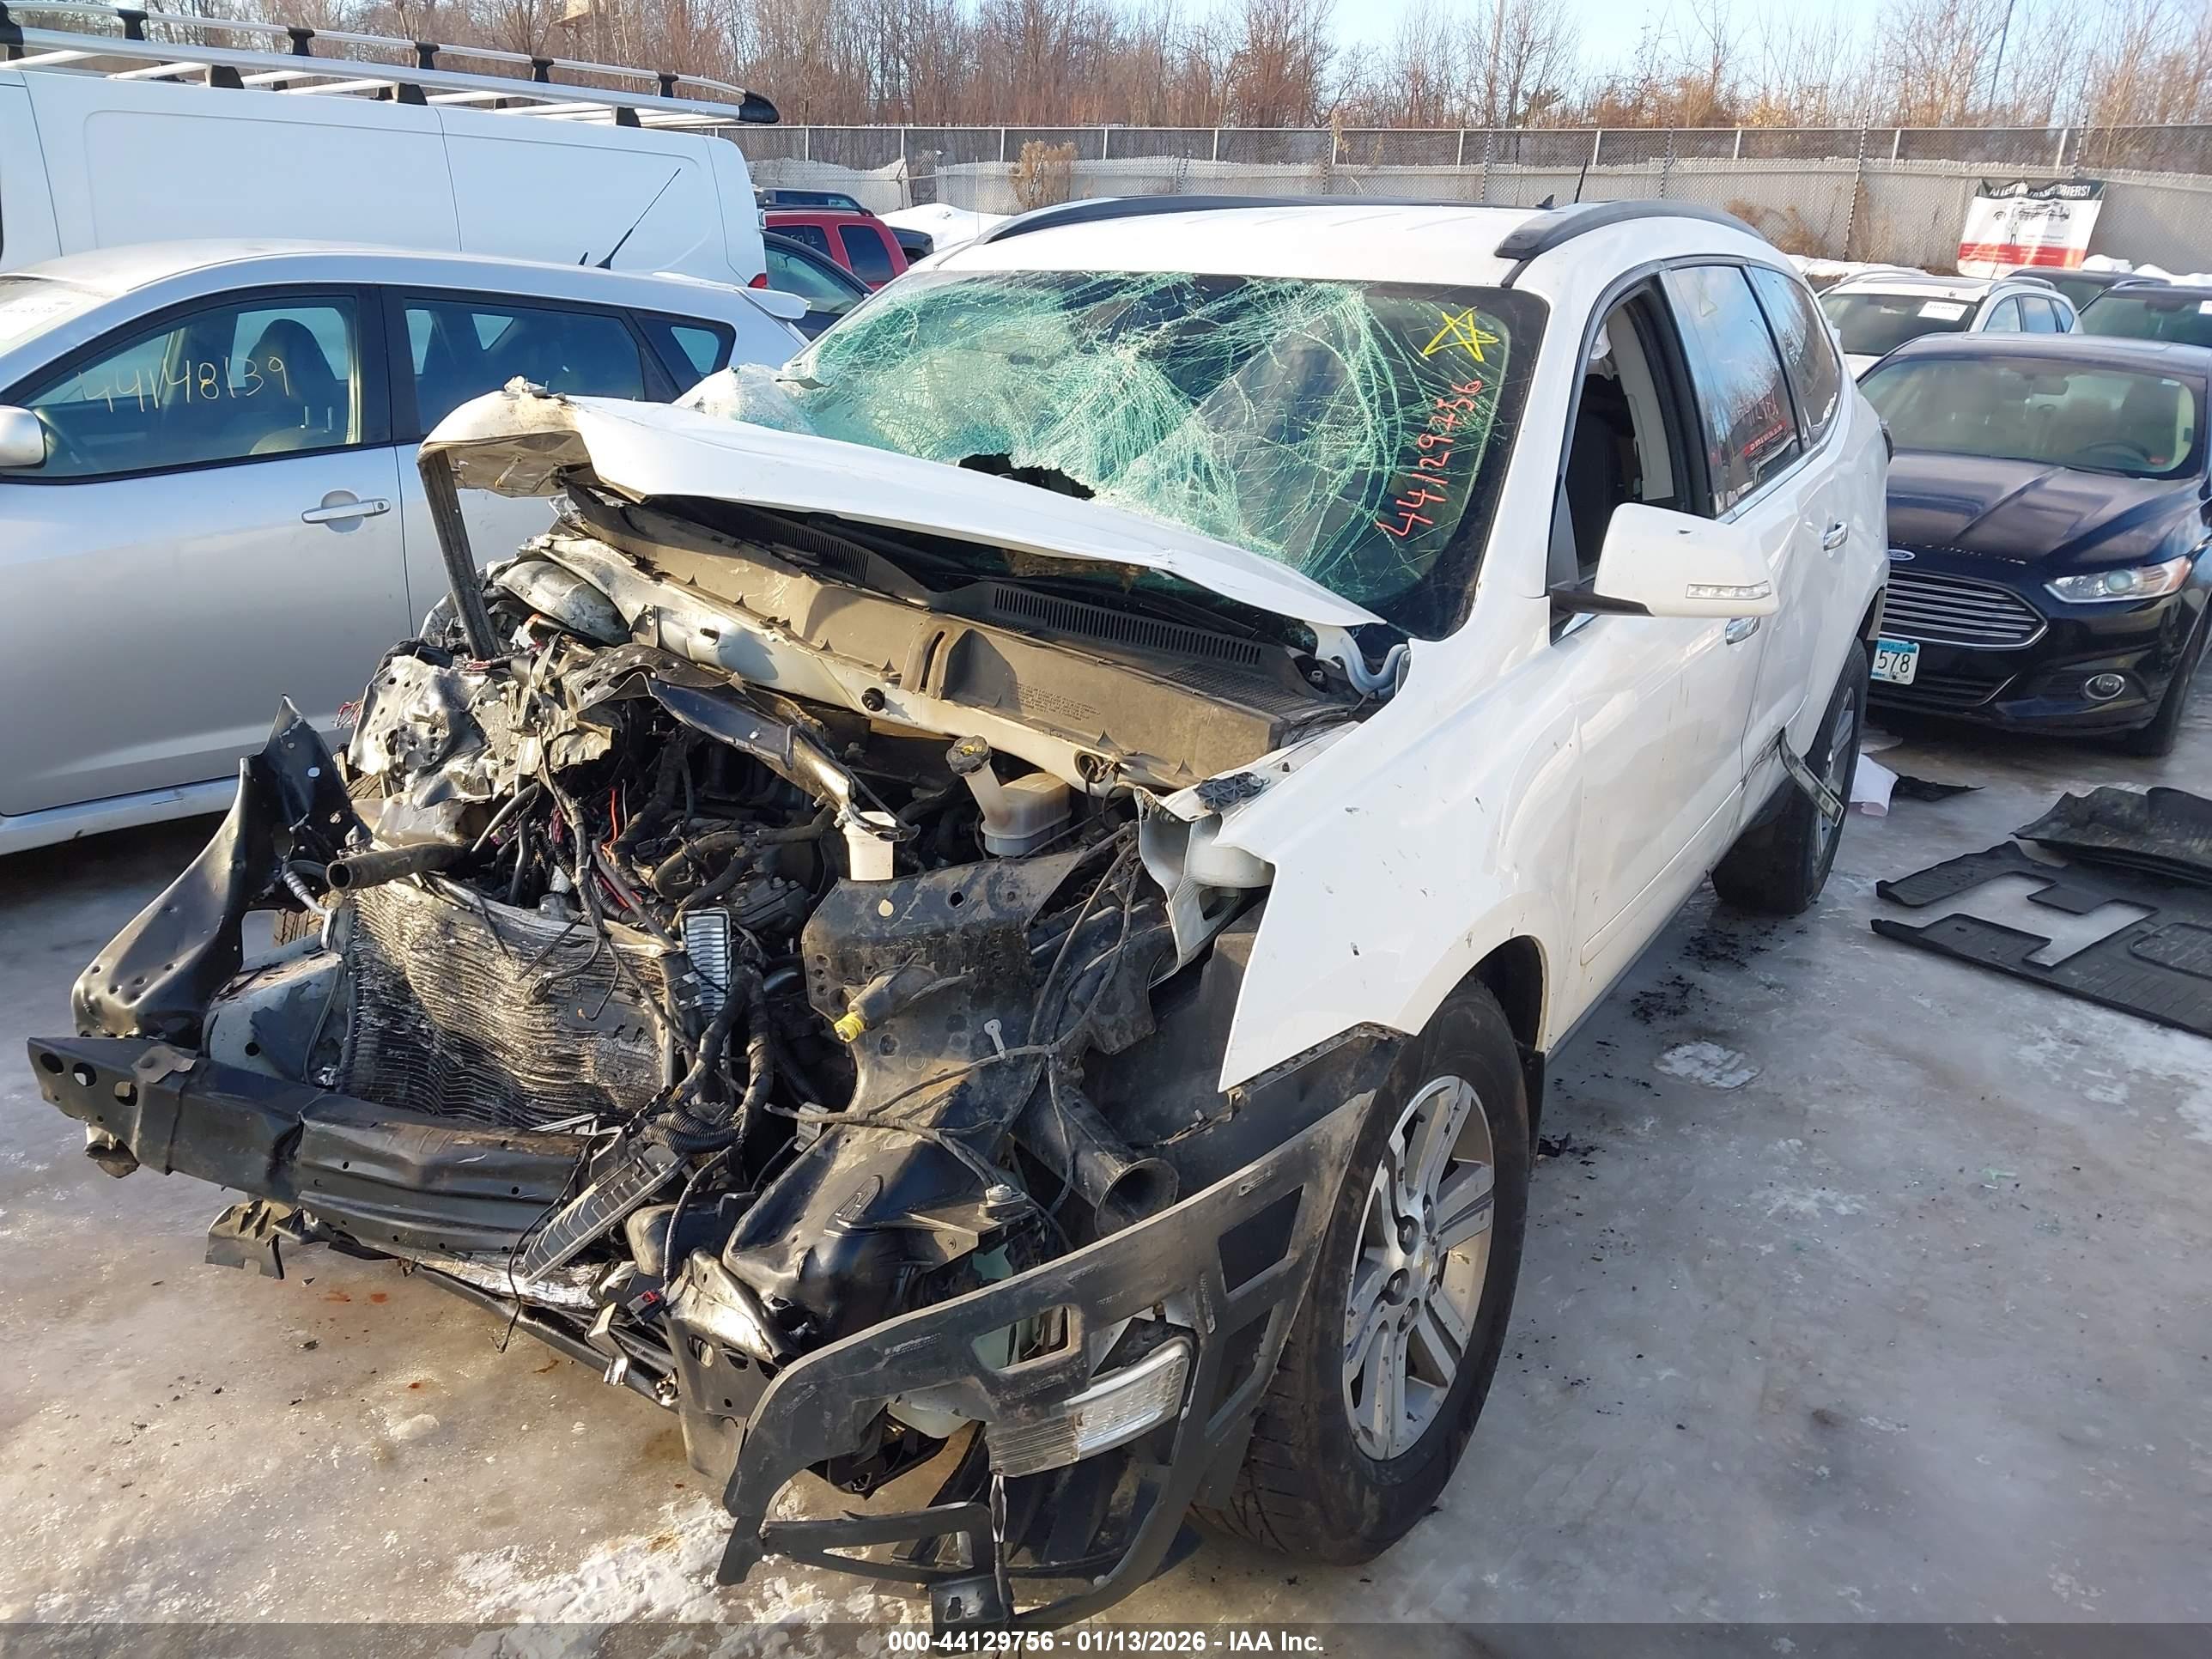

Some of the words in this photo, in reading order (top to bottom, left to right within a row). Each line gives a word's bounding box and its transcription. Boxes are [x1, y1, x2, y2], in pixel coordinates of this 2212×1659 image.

[77, 356, 289, 412] 44148139
[1376, 380, 1483, 537] 44129756
[1877, 650, 1911, 673] 578
